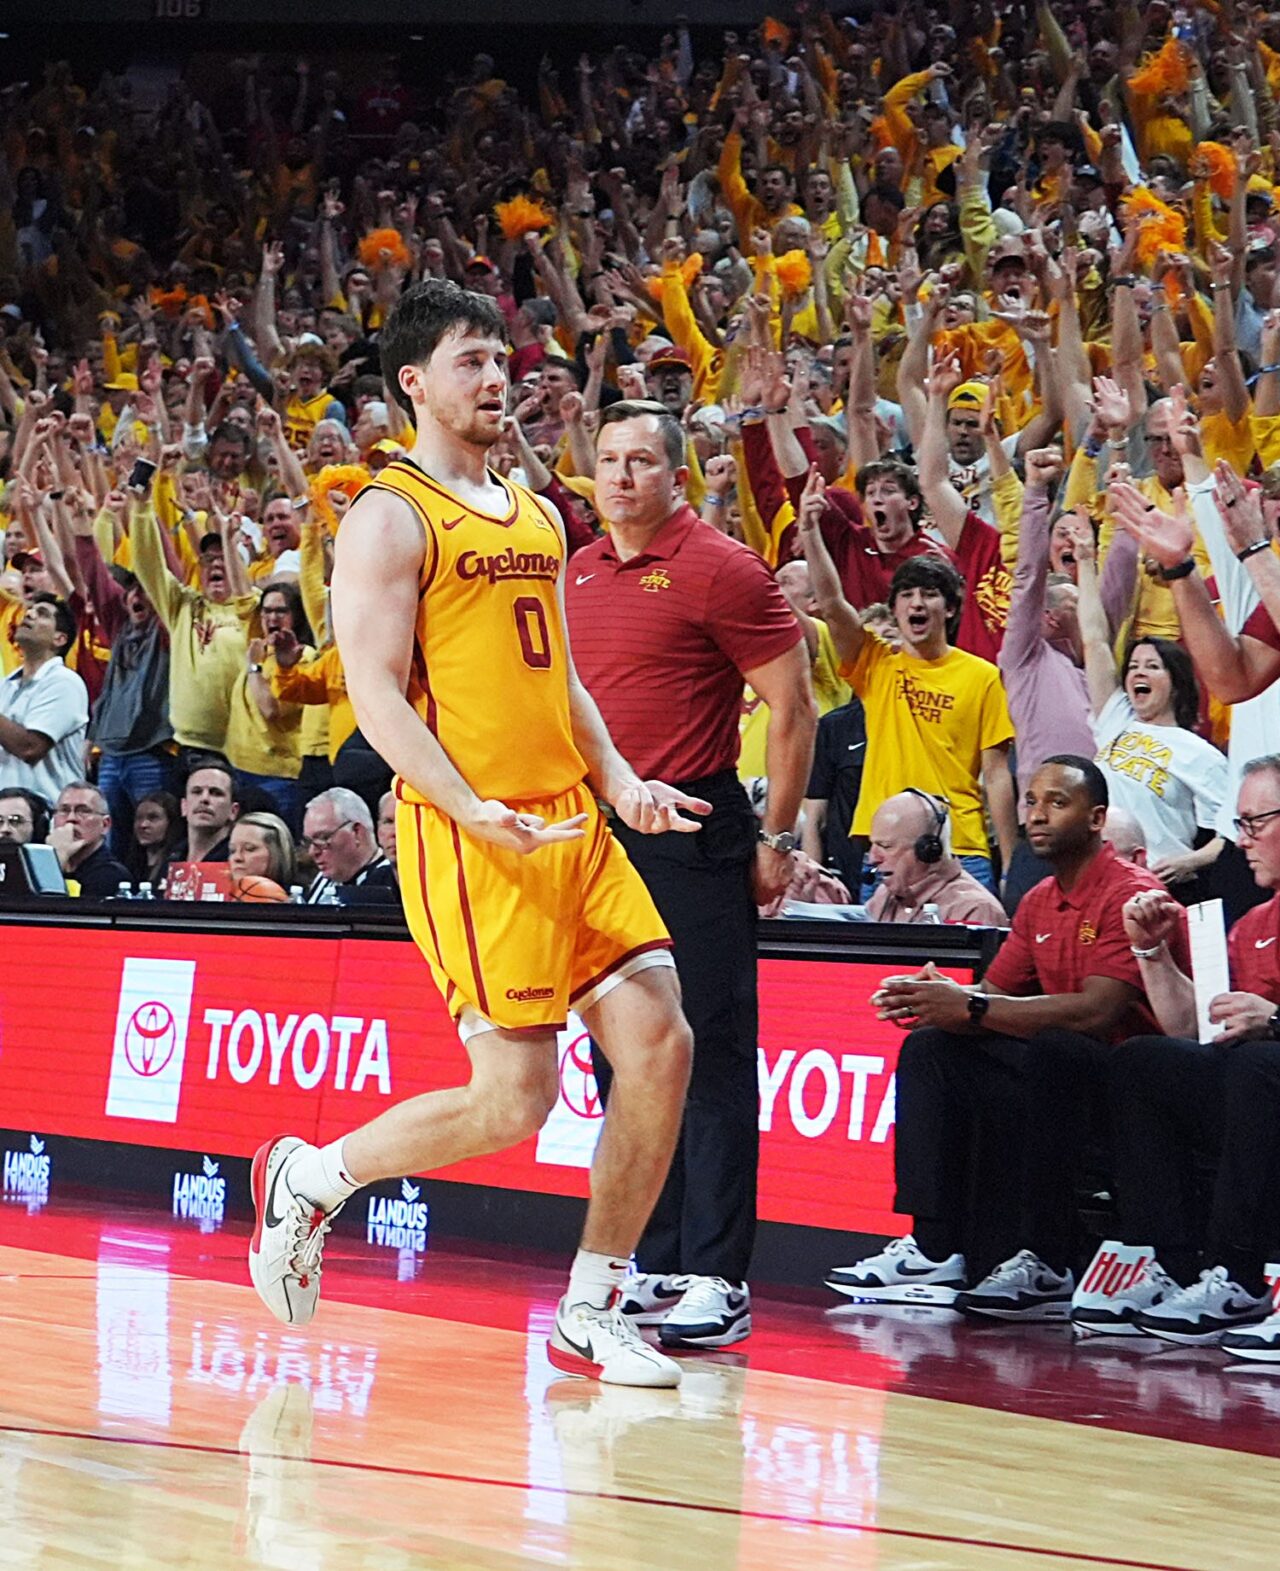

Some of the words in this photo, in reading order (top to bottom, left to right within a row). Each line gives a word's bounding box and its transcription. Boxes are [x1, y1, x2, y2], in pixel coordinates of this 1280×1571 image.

[513, 596, 552, 670] 0
[203, 1008, 392, 1095] TOYOTA
[4, 1151, 51, 1180] LANDUS
[173, 1172, 226, 1204] LANDUS
[368, 1196, 428, 1231] LANDUS
